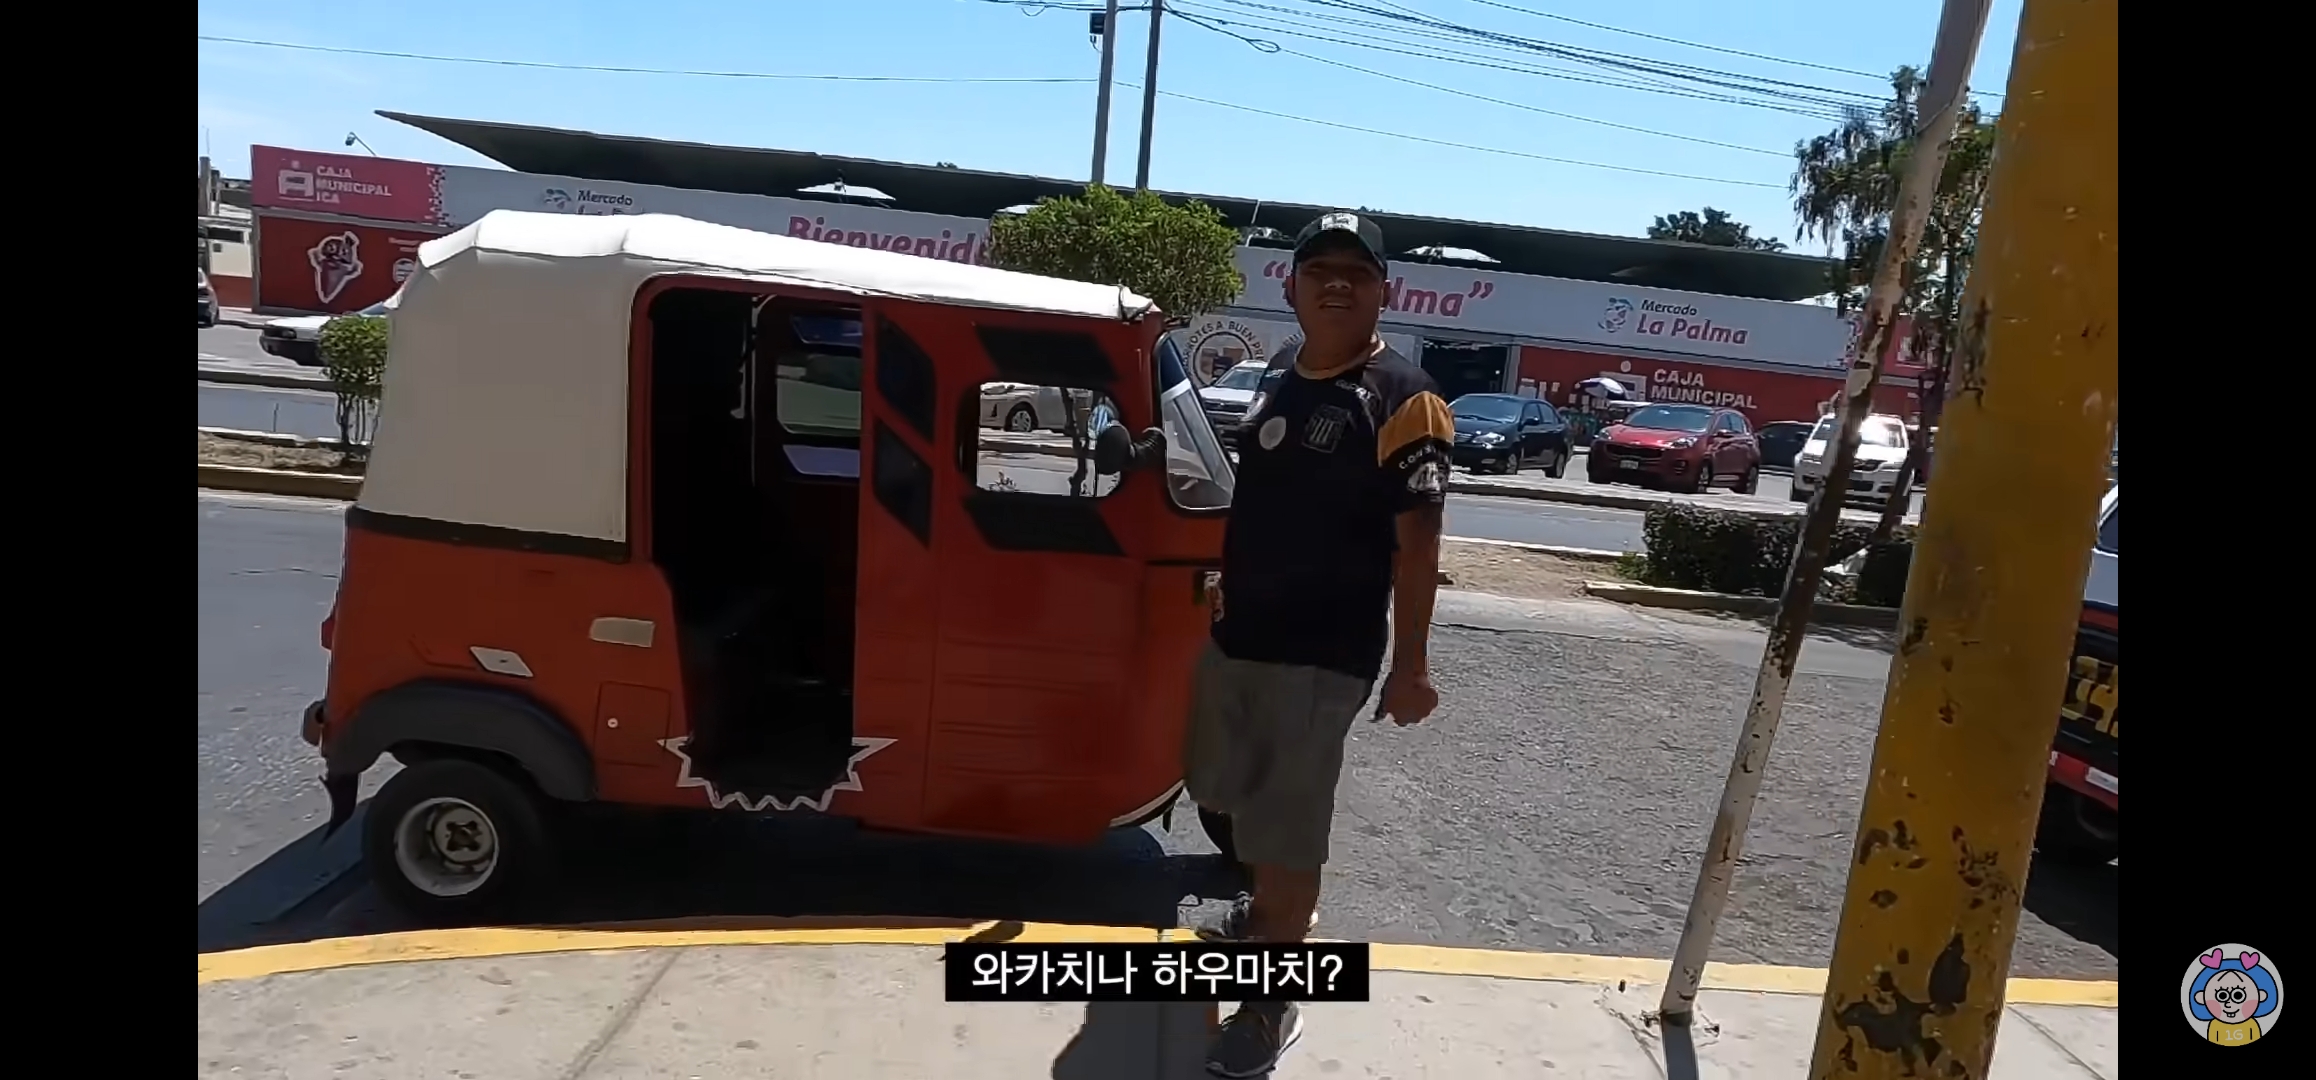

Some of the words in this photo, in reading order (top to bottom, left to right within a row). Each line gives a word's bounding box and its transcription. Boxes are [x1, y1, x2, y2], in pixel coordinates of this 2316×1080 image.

[316, 165, 352, 179] CAJA
[315, 177, 392, 197] MUNICIPAL
[316, 191, 340, 204] ICA
[578, 189, 634, 206] Mercado
[1640, 299, 1698, 316] Mercado
[1636, 313, 1665, 336] La
[1670, 318, 1748, 345] Palma
[1653, 368, 1705, 388] CAJA
[1650, 385, 1758, 409] MUNICIPAL
